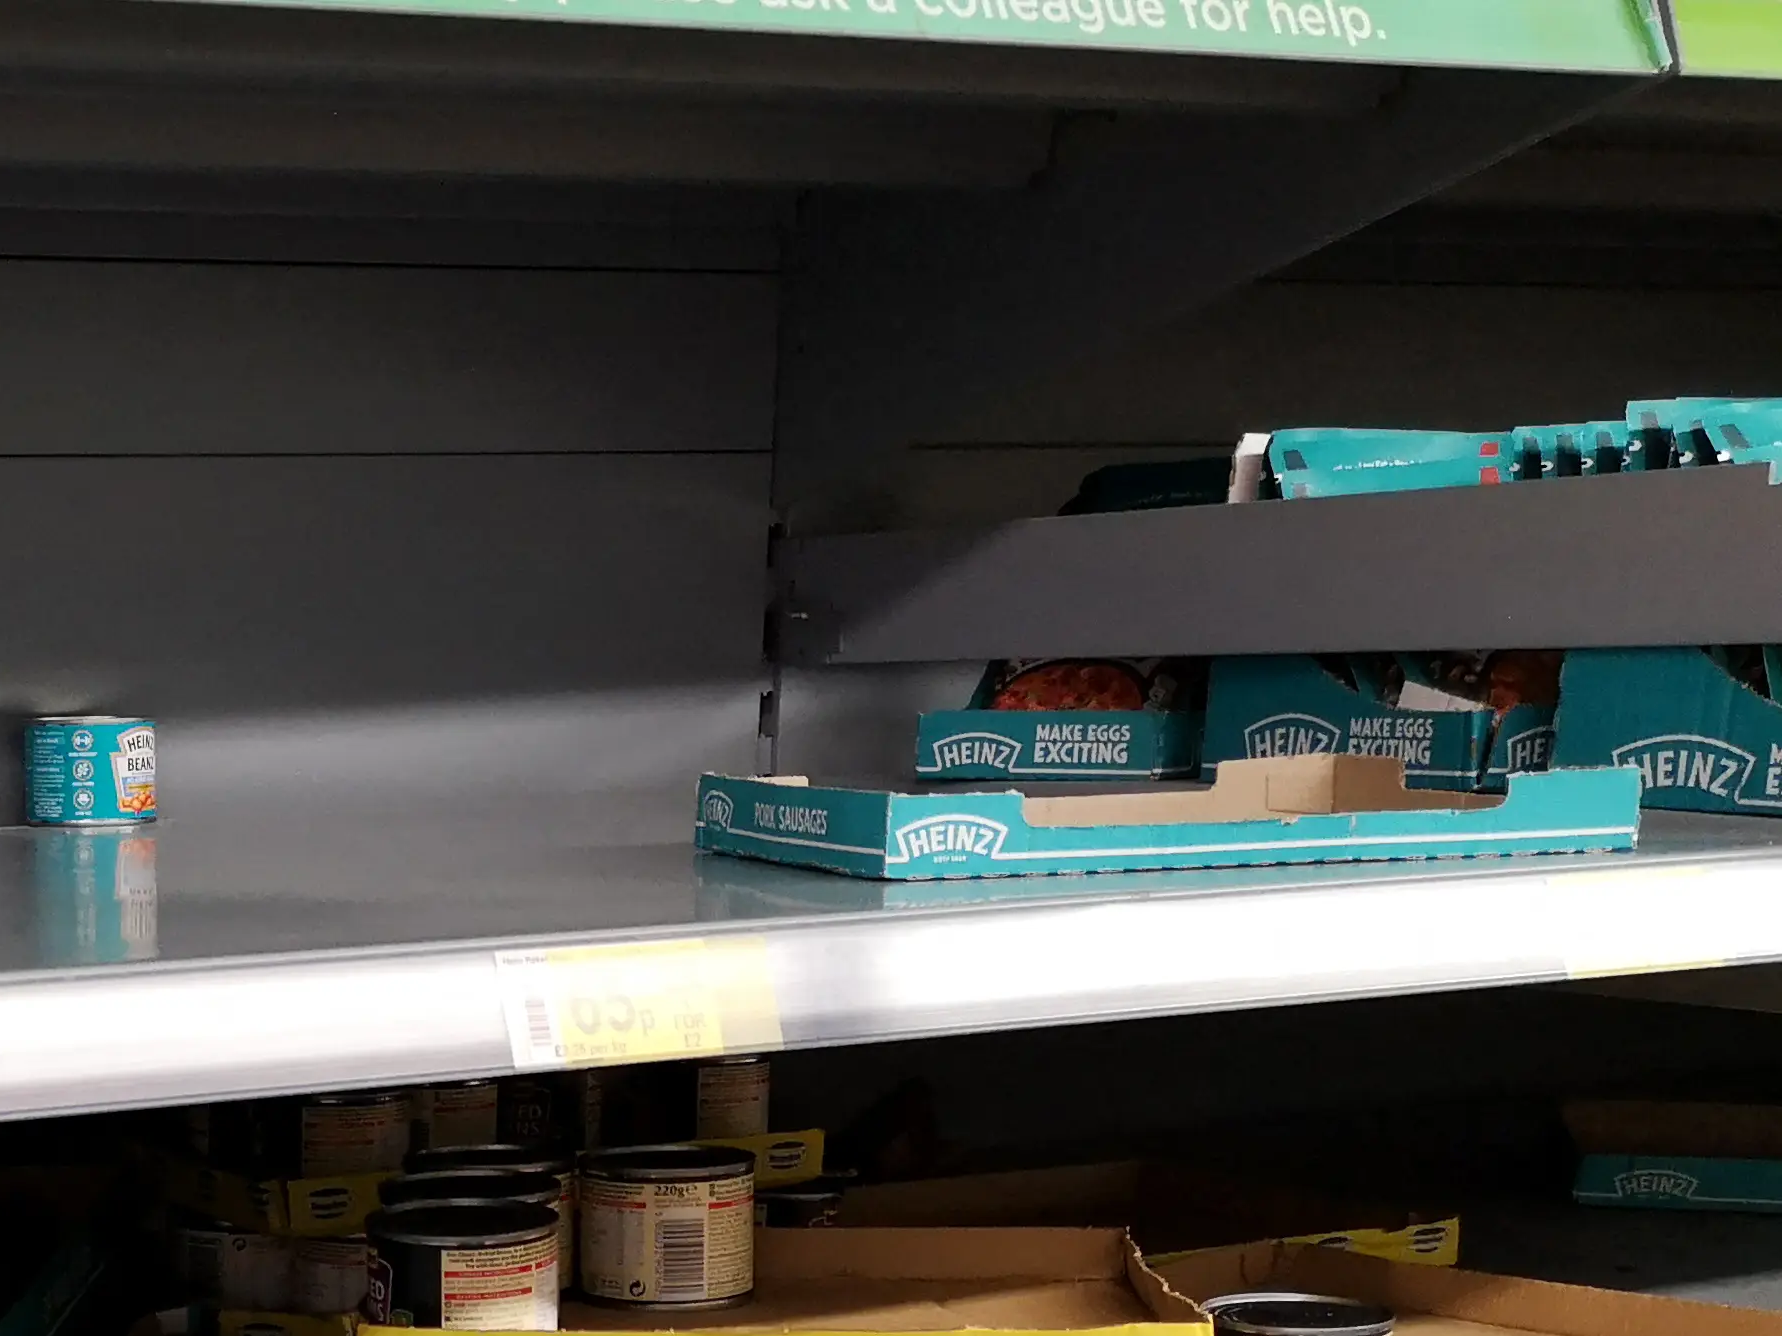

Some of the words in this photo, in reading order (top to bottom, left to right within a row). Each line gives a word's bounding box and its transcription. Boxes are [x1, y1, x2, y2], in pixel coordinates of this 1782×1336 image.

[920, 0, 1166, 34] colleague
[1181, 0, 1249, 32] for
[1268, 0, 1386, 46] help.
[127, 731, 155, 752] HEINZ
[1035, 724, 1090, 741] MAKE
[1093, 723, 1131, 743] EGGS
[1254, 728, 1330, 757] HEINZ
[1349, 717, 1395, 737] MAKE
[1398, 717, 1435, 739] EGGS
[127, 754, 155, 772] BEANZ
[943, 741, 1012, 770] HEINZ
[1033, 740, 1130, 765] EXCITING
[1347, 737, 1433, 766] EXCITING
[1628, 749, 1740, 798] HEINZ
[754, 802, 776, 830] PORK
[777, 806, 829, 836] SAUSAGES
[911, 822, 993, 858] HEINZ
[1624, 1174, 1691, 1199] HEINZ
